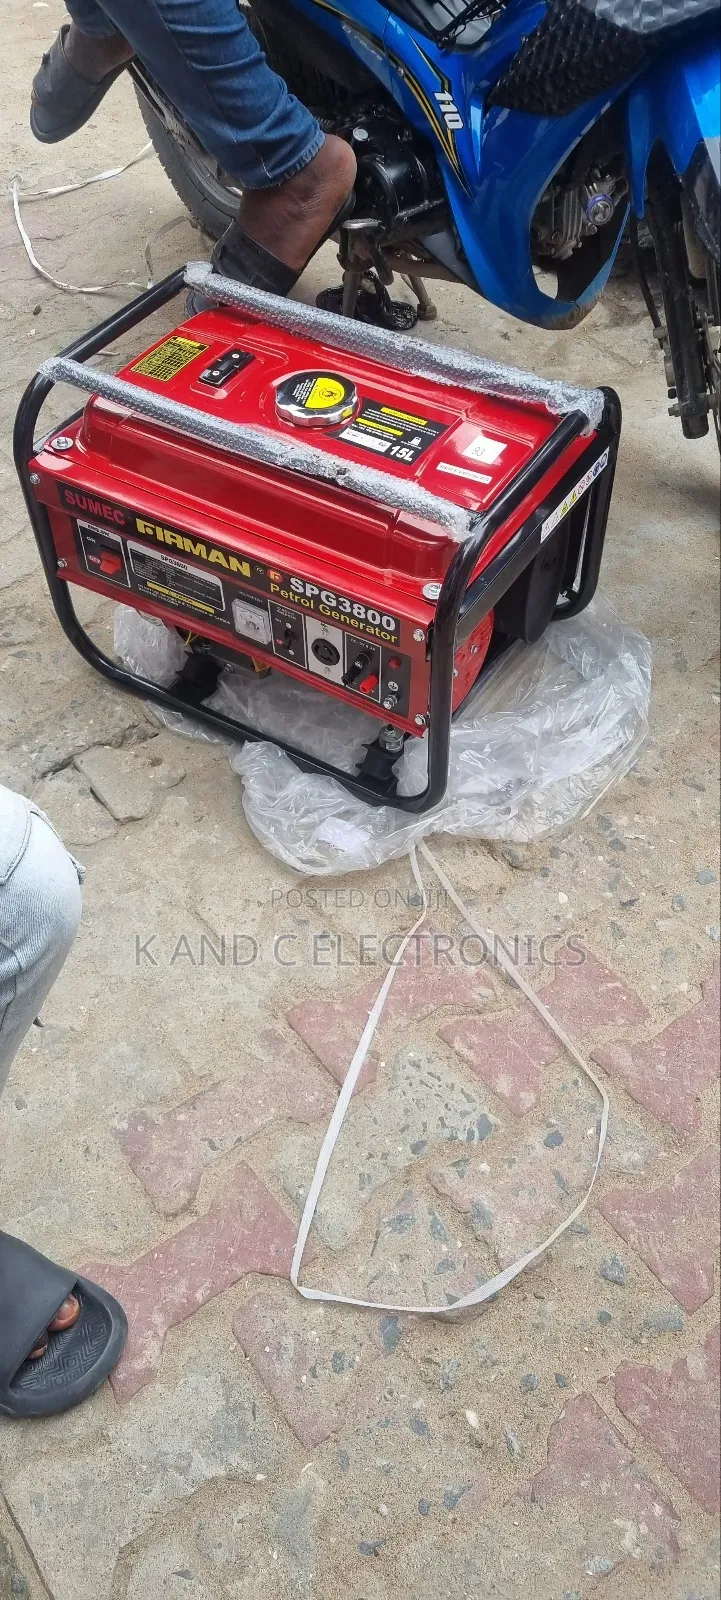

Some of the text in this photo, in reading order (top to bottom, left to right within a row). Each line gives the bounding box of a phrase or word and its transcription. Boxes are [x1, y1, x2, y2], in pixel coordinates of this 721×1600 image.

[433, 90, 464, 129] 110
[389, 445, 416, 462] 15L
[471, 446, 485, 457] 93
[64, 489, 126, 526] SUMEC
[135, 517, 251, 578] FIRMAN
[270, 582, 314, 609] Petrol
[319, 604, 398, 643] Generator
[290, 577, 396, 631] SPG3800
